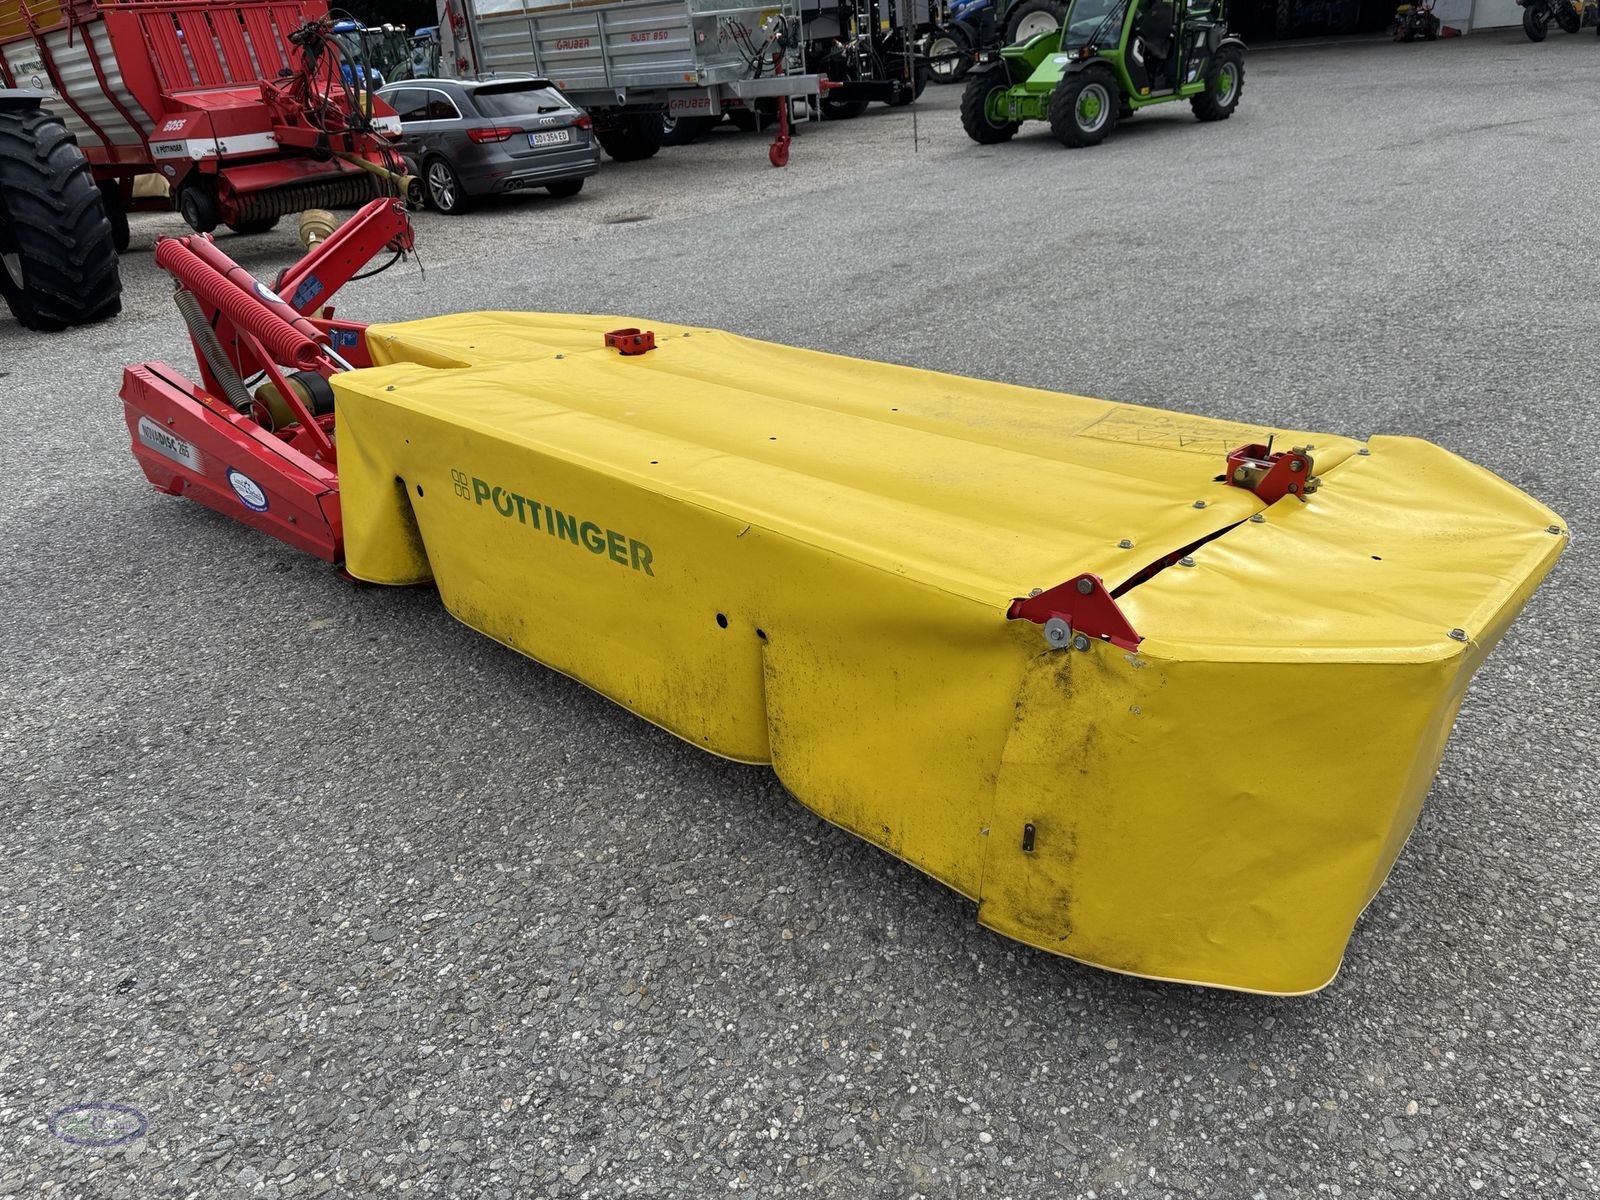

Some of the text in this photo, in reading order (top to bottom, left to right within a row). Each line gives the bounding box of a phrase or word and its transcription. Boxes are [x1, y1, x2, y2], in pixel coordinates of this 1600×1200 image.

[630, 33, 651, 42] GUST
[556, 38, 590, 50] GRUBER
[670, 96, 711, 109] GRUBER
[471, 476, 656, 577] PÖTTINGER
